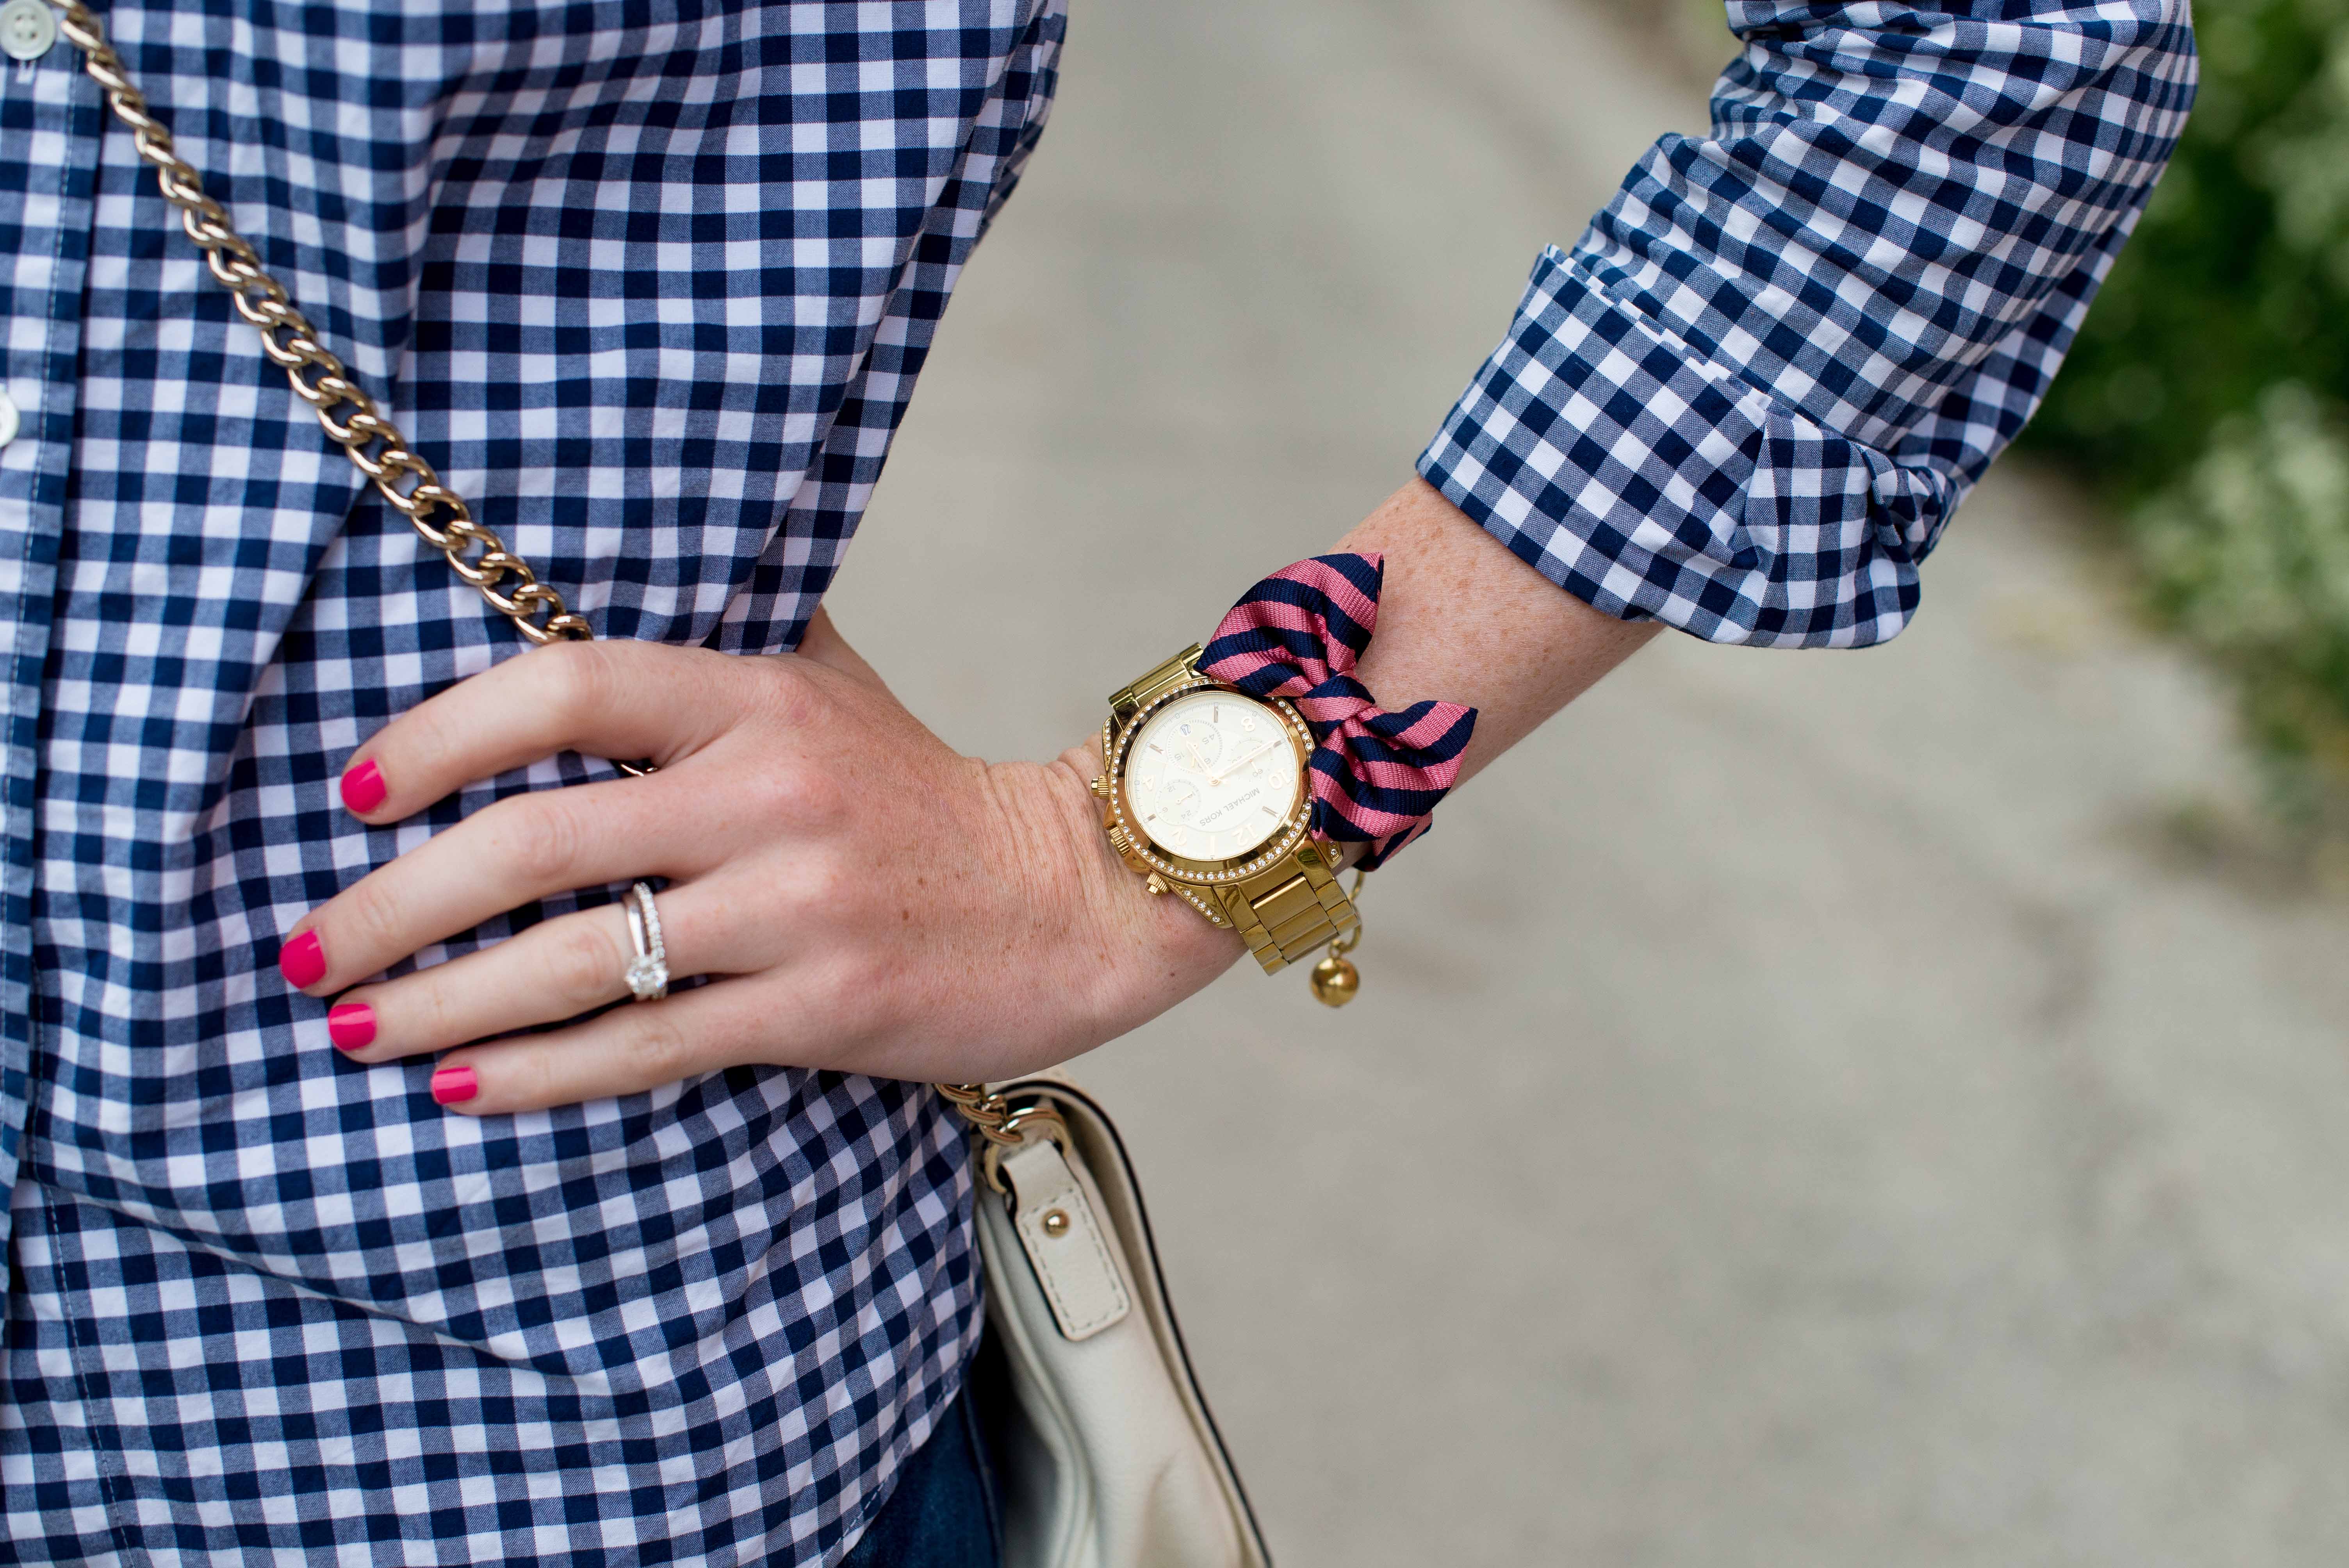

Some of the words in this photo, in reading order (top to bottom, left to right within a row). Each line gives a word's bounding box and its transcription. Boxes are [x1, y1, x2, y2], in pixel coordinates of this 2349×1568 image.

[1240, 716, 1255, 733] 8
[1202, 734, 1214, 745] 45
[1174, 751, 1185, 761] 15
[1142, 775, 1154, 792] 4
[1268, 768, 1290, 789] 10
[1223, 787, 1260, 813] MICHAEL
[1181, 809, 1191, 819] 24
[1199, 809, 1222, 827] KORS
[1171, 827, 1187, 846] 2
[1232, 824, 1257, 849] 12
